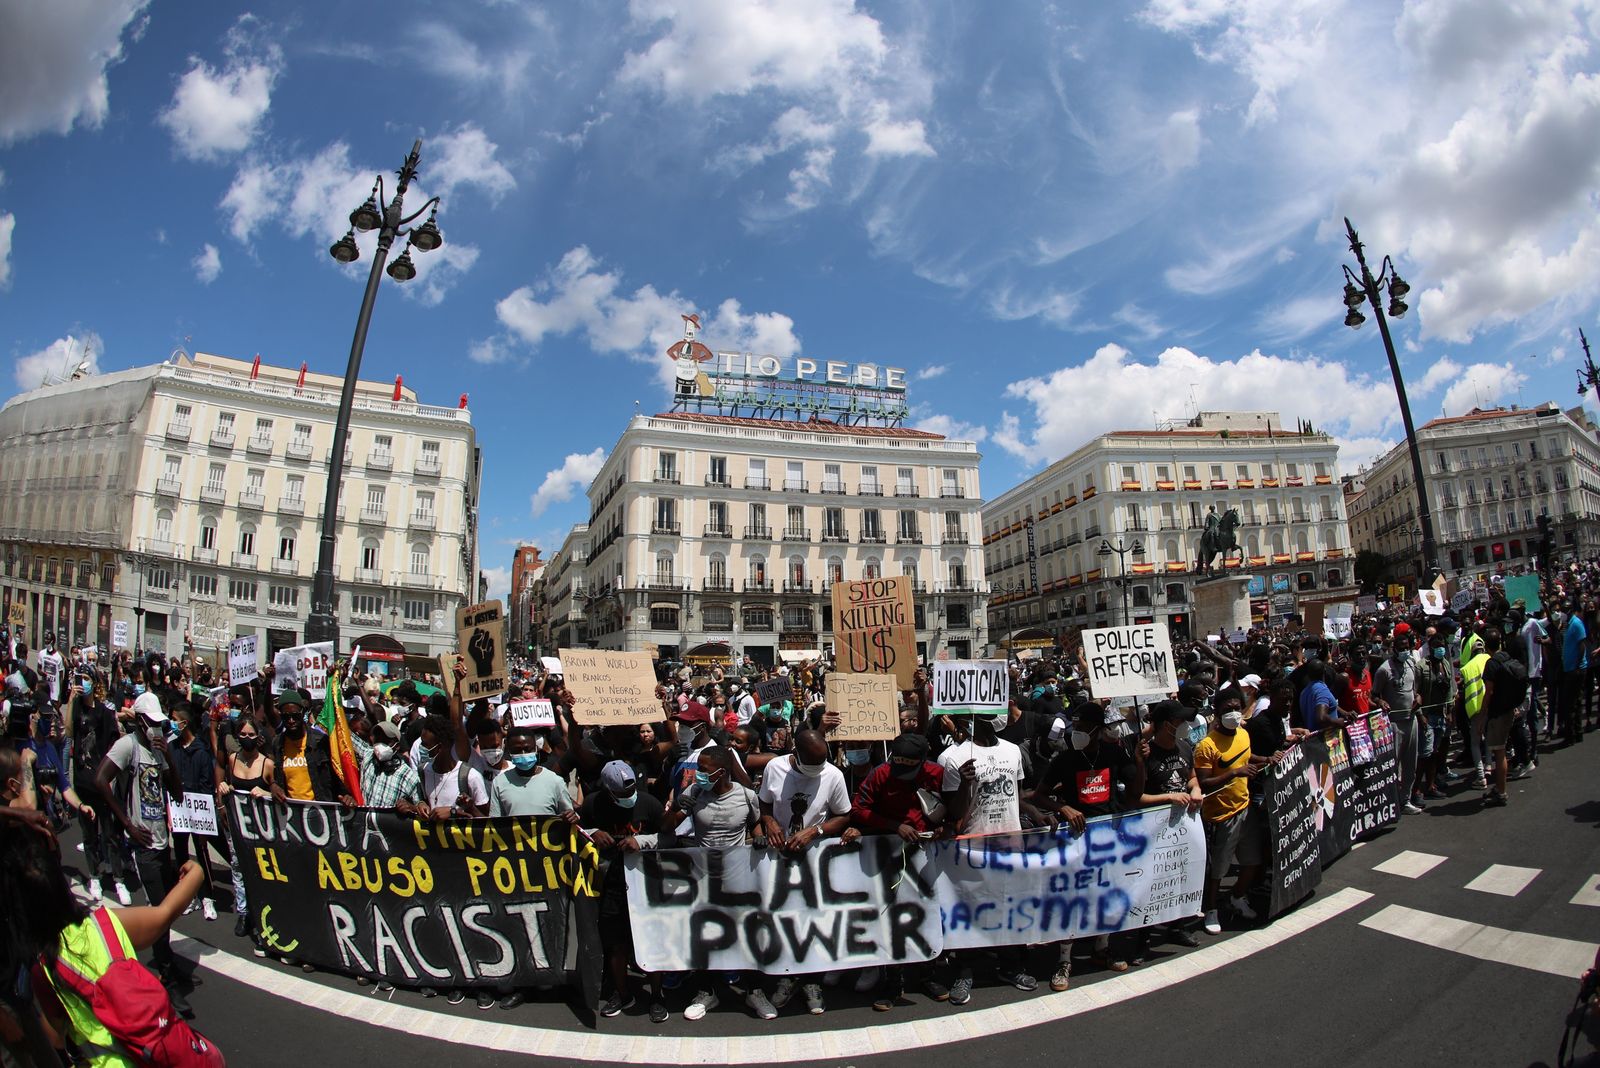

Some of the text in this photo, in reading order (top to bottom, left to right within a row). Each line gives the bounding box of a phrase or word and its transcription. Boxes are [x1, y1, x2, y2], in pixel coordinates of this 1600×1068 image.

[718, 351, 780, 376] TIO
[797, 358, 906, 389] PEPE
[1027, 522, 1035, 551] HOTEL
[849, 580, 897, 601] STOP
[463, 608, 499, 627] NO JUSTICE
[840, 603, 905, 631] KILLING
[1094, 628, 1155, 653] POLICE
[564, 655, 638, 670] BROWN WORLD
[1091, 651, 1167, 681] REFORM
[582, 673, 612, 683] BLANCOS
[937, 669, 1006, 703] ¡JUSTICIA!
[468, 681, 480, 695] NO
[608, 684, 641, 695] NEGROS
[575, 697, 640, 705] ODOS DIFERENTES
[848, 698, 876, 708] FOR
[514, 704, 553, 720] JUSTICIA!
[586, 709, 606, 717] TONOS
[839, 711, 888, 722] FLOYD
[1085, 775, 1103, 784] FUCK
[1336, 776, 1355, 797] CADA
[1363, 766, 1380, 780] SER
[185, 796, 192, 808] la
[193, 798, 211, 814] paz,
[1343, 798, 1352, 809] ES
[234, 795, 391, 852] EUROPA
[254, 847, 290, 884] EL
[317, 849, 435, 898] ABUSO
[643, 837, 935, 909] BLACK
[1150, 874, 1188, 892] ADAMA
[688, 901, 933, 970] POWER
